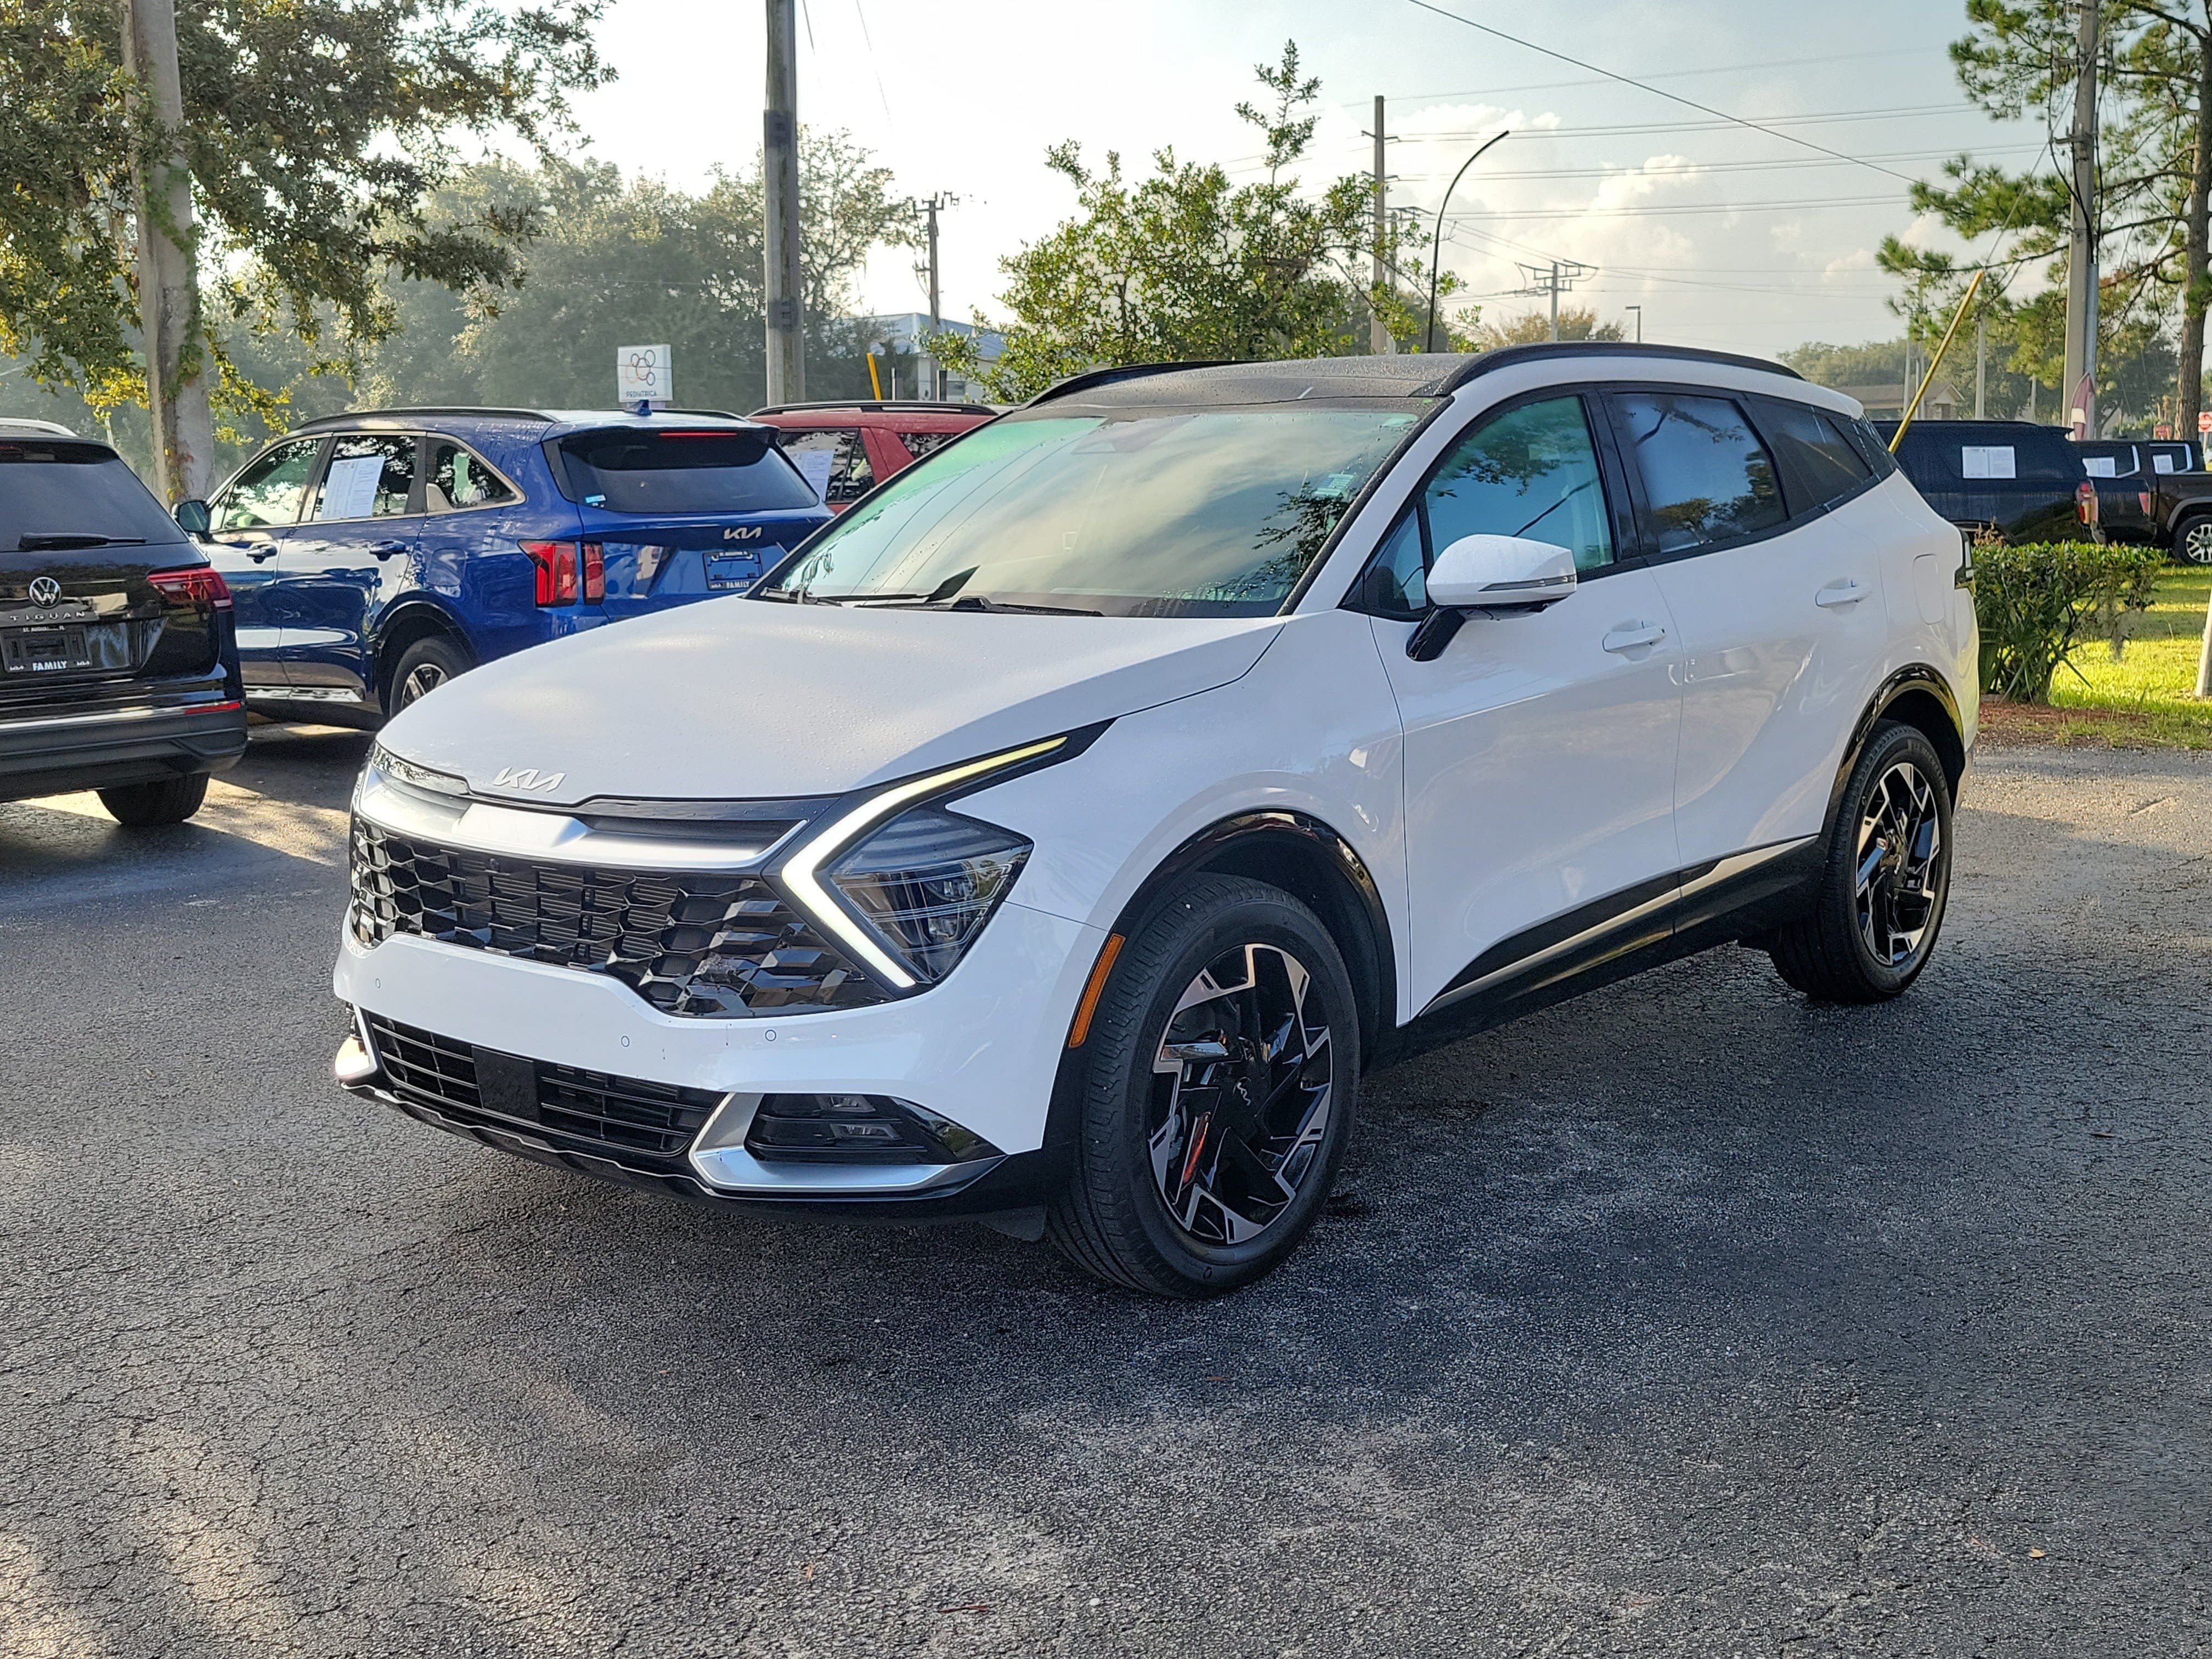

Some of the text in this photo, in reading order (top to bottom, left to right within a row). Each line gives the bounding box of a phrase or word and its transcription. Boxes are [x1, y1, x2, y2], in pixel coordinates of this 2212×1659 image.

[724, 527, 762, 540] KIA
[10, 611, 85, 622] TIGUAN
[32, 661, 67, 672] FAMILY
[493, 766, 567, 793] KIA
